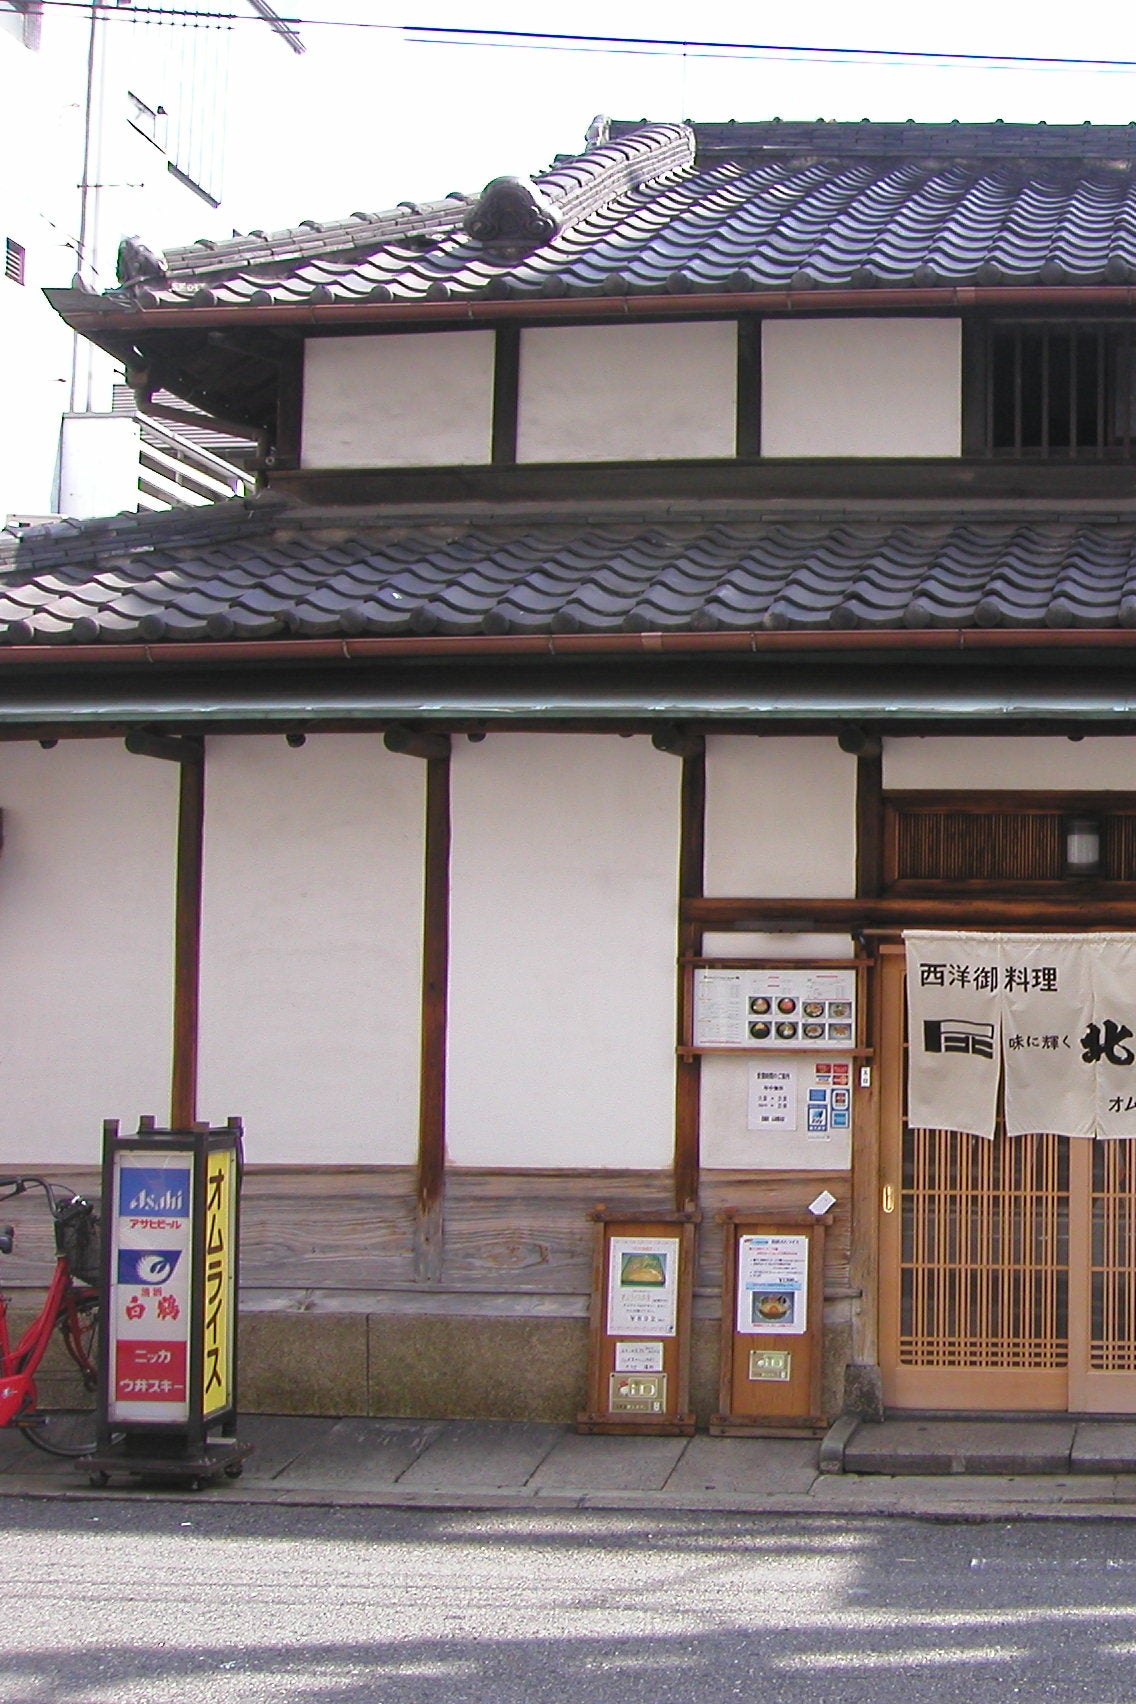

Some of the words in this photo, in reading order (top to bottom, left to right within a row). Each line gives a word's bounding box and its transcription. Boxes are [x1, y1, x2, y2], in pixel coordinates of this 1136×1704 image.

[920, 963, 1057, 992] 西洋御料理
[1009, 1034, 1071, 1050] 味に輝く
[129, 1189, 183, 1210] Asahi
[130, 1219, 182, 1229] アサヒビール
[207, 1168, 224, 1394] オムライス
[126, 1295, 180, 1320] 白鶴
[134, 1350, 171, 1363] ニッカ
